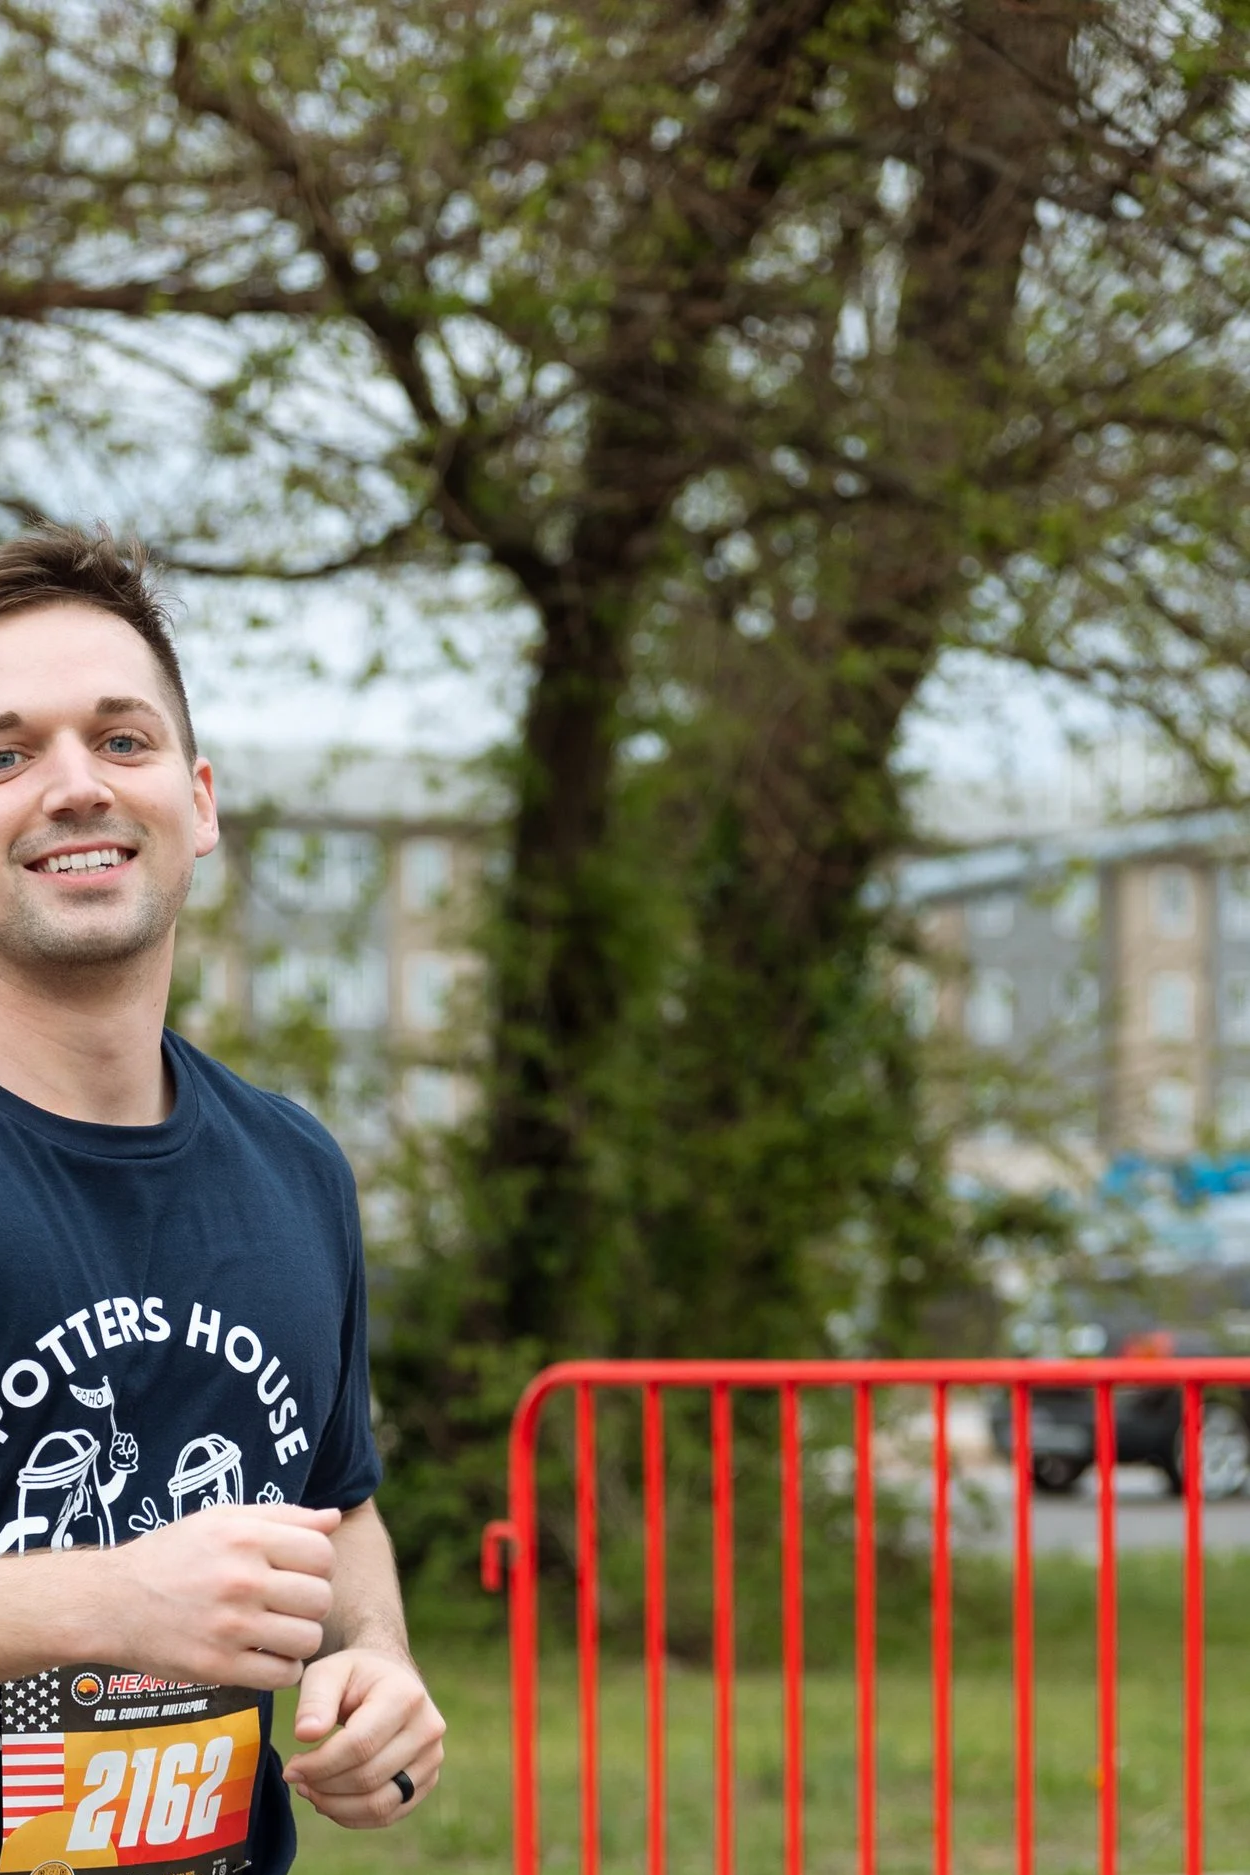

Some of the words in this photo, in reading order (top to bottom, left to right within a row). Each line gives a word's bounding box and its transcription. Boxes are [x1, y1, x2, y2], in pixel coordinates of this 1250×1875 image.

[75, 1388, 104, 1406] POHO
[185, 1302, 309, 1466] HOUSE
[94, 1708, 116, 1722] GOD.
[119, 1704, 159, 1720] COUNTRY.
[161, 1699, 208, 1716] MULTISPORT.
[66, 1736, 233, 1852] 2162
